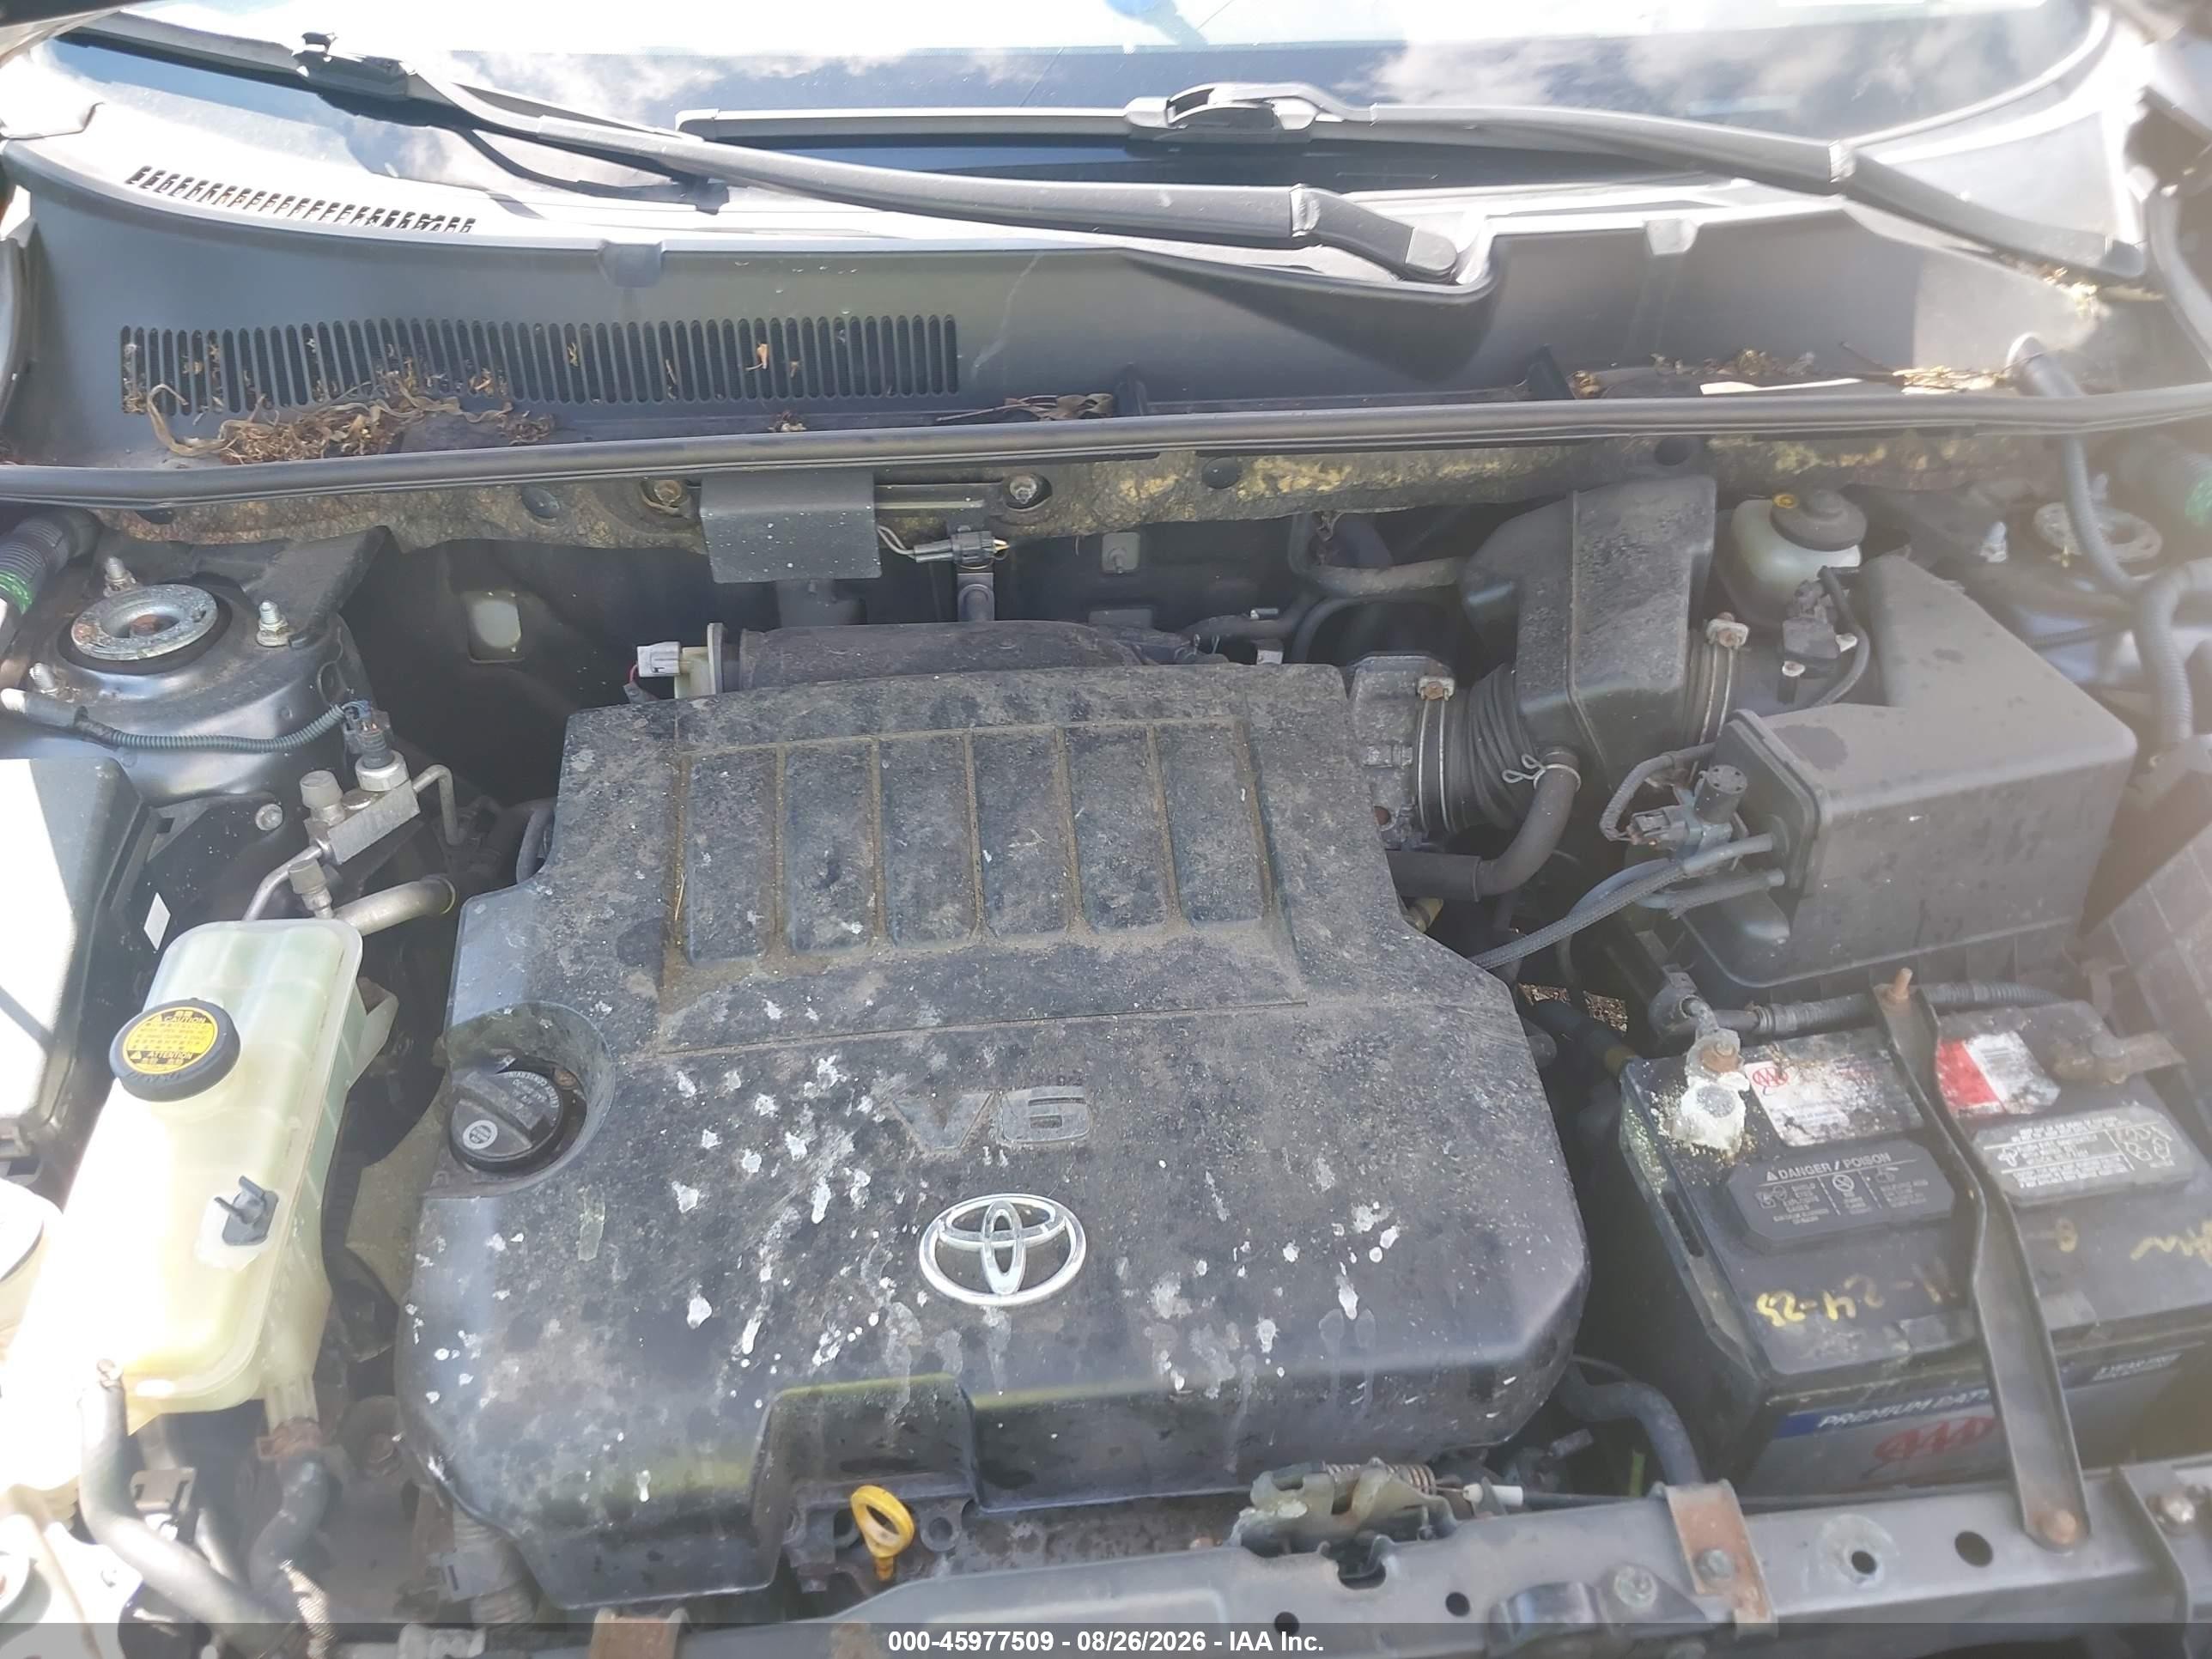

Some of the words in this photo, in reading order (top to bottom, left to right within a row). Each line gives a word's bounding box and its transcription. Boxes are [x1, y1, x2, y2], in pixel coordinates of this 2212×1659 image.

[891, 1085, 1091, 1150] V6
[1778, 1162, 1832, 1180] DANGER
[1844, 1152, 1892, 1169] POISON
[1817, 1398, 1933, 1428] PREMIUM
